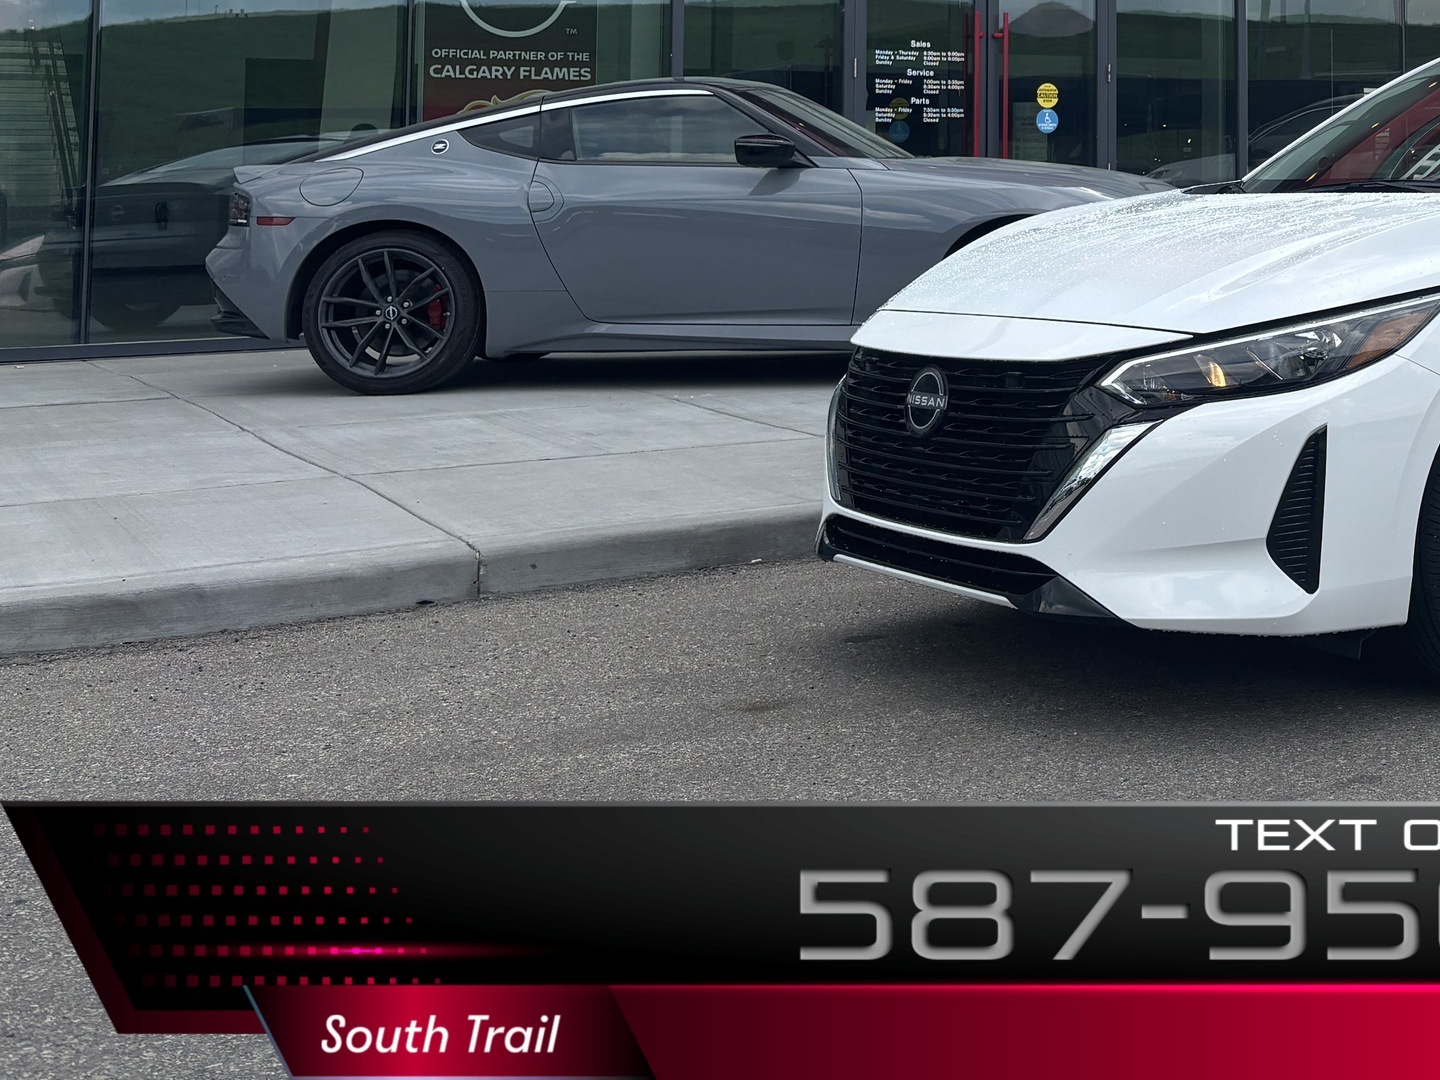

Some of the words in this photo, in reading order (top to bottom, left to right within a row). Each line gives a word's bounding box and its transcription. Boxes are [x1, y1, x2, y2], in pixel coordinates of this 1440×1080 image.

[910, 40, 931, 48] Sales
[431, 48, 487, 59] OFFICIAL
[489, 50, 546, 60] PARTNER
[548, 52, 564, 60] OF
[567, 52, 590, 61] THE
[429, 64, 515, 80] CALGARY
[519, 66, 592, 81] FLAMES
[906, 68, 934, 76] Service
[907, 393, 945, 407] NISSAN
